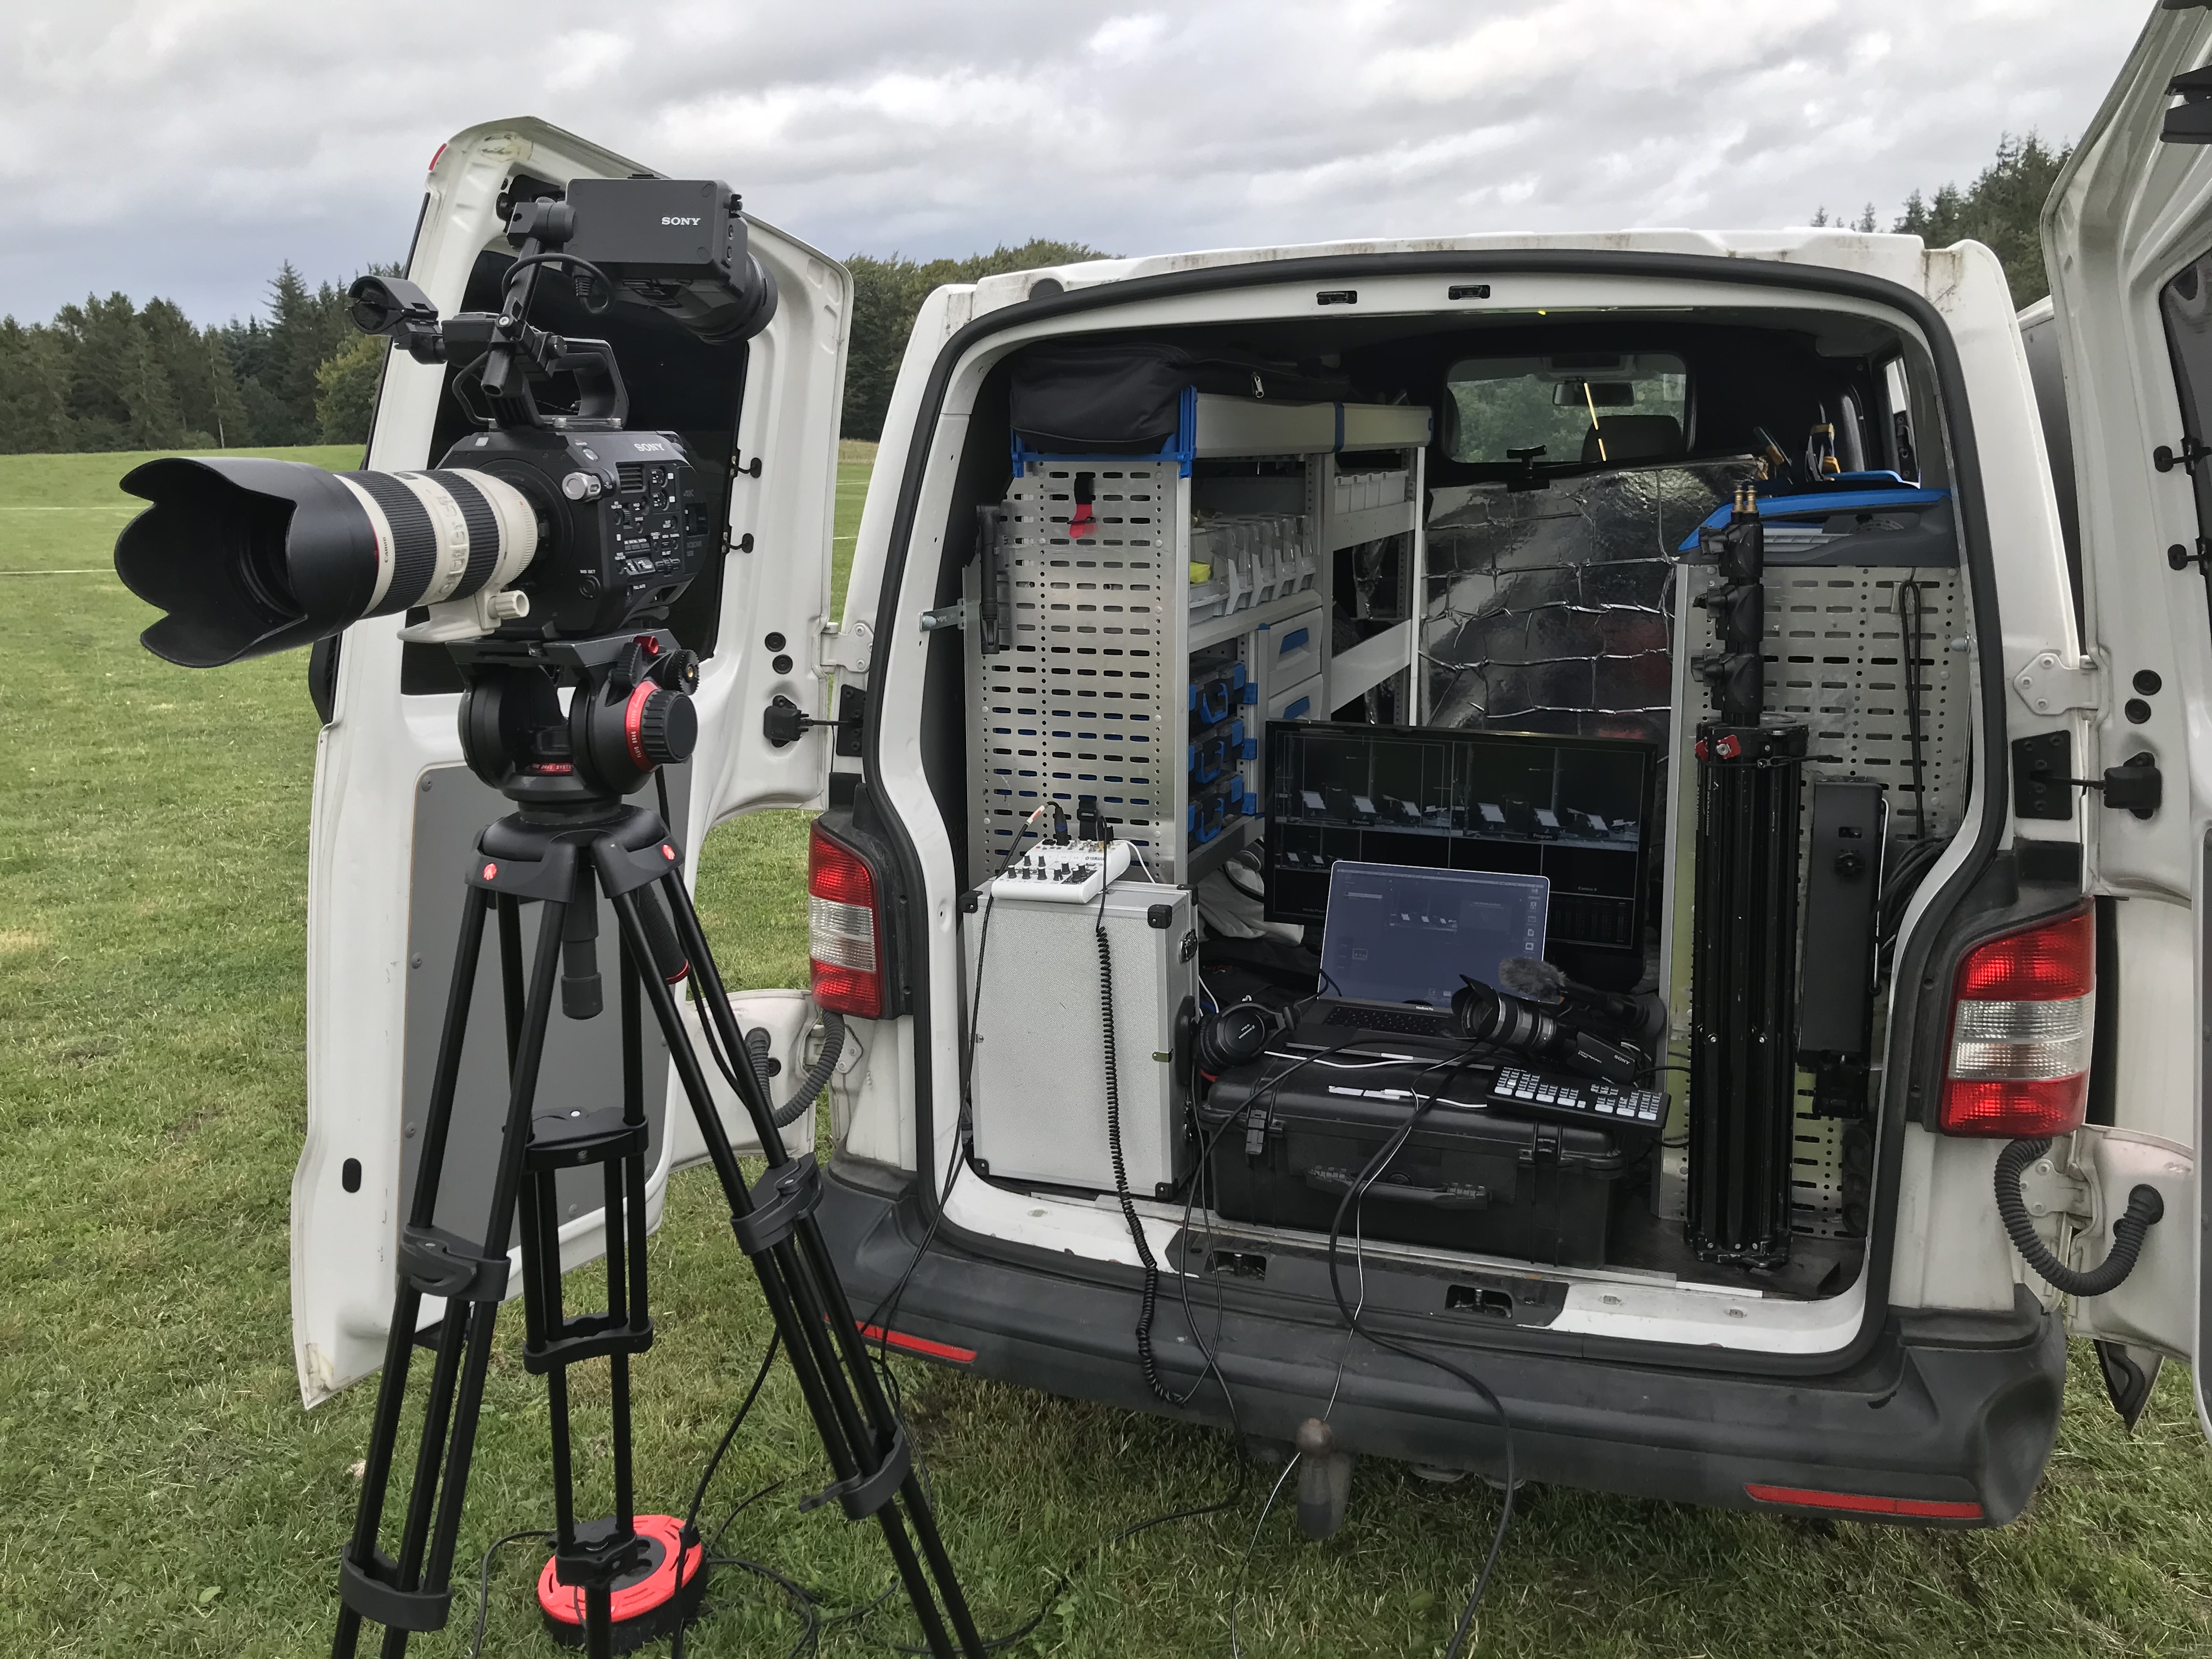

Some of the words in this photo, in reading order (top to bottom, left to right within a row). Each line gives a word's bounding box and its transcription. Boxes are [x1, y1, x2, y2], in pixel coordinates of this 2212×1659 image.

[662, 217, 701, 225] SONY
[634, 443, 665, 452] SONY
[634, 746, 642, 758] FLUID
[1614, 1054, 1630, 1065] SONY
